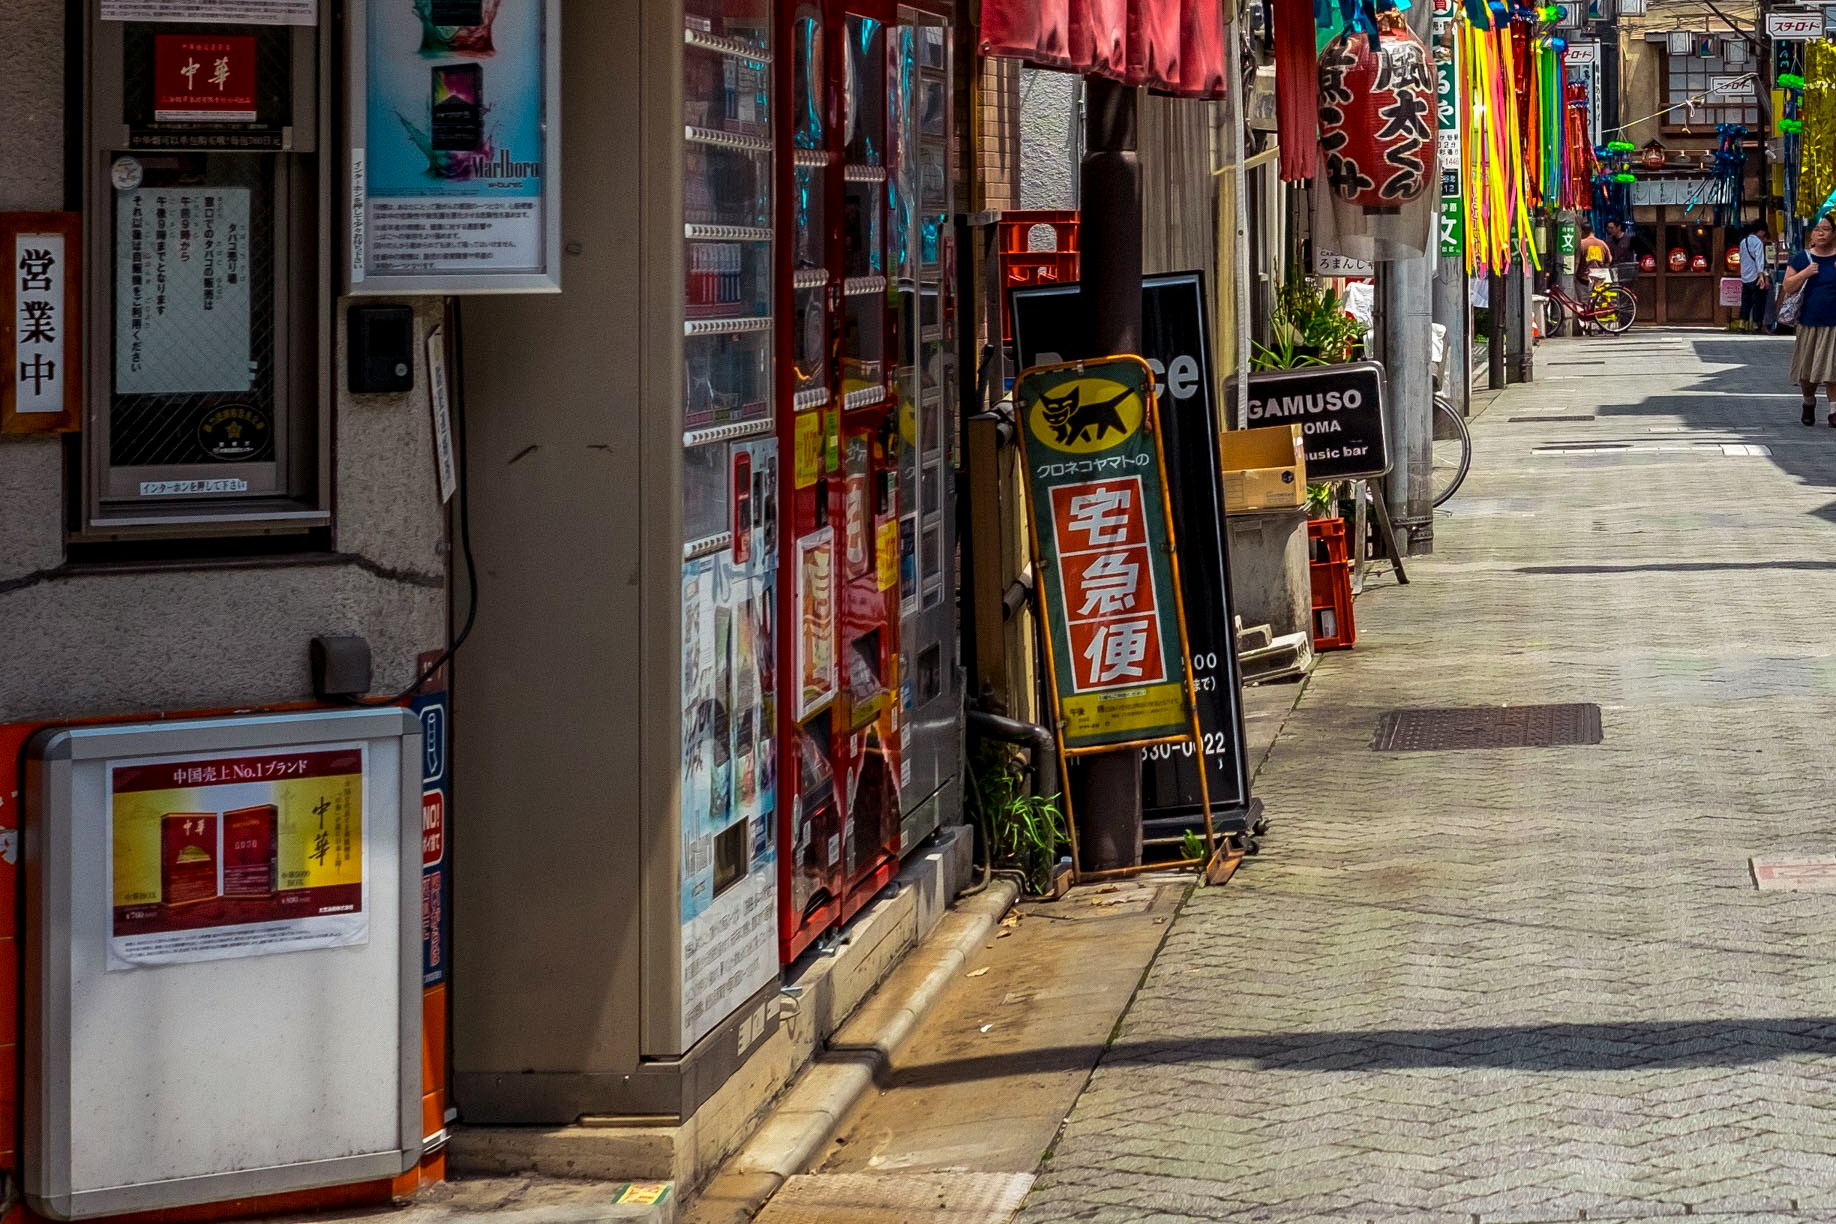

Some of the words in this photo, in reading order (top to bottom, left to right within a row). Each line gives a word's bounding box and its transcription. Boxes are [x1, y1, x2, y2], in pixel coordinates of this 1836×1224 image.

[1774, 21, 1822, 32] スターロード
[1565, 50, 1593, 61] ーロード
[179, 57, 231, 91] 中華
[470, 149, 540, 179] Marlboro
[1561, 233, 1574, 248] 文
[20, 249, 56, 396] 営業中
[1247, 389, 1362, 420] GAMUSO
[1036, 452, 1150, 479] クロネコヤマトの
[1304, 448, 1340, 462] usic
[1343, 445, 1368, 458] bar
[143, 481, 245, 493] インターホンを押して下さい
[1067, 487, 1148, 684] 宅急便
[309, 796, 332, 867] 中華
